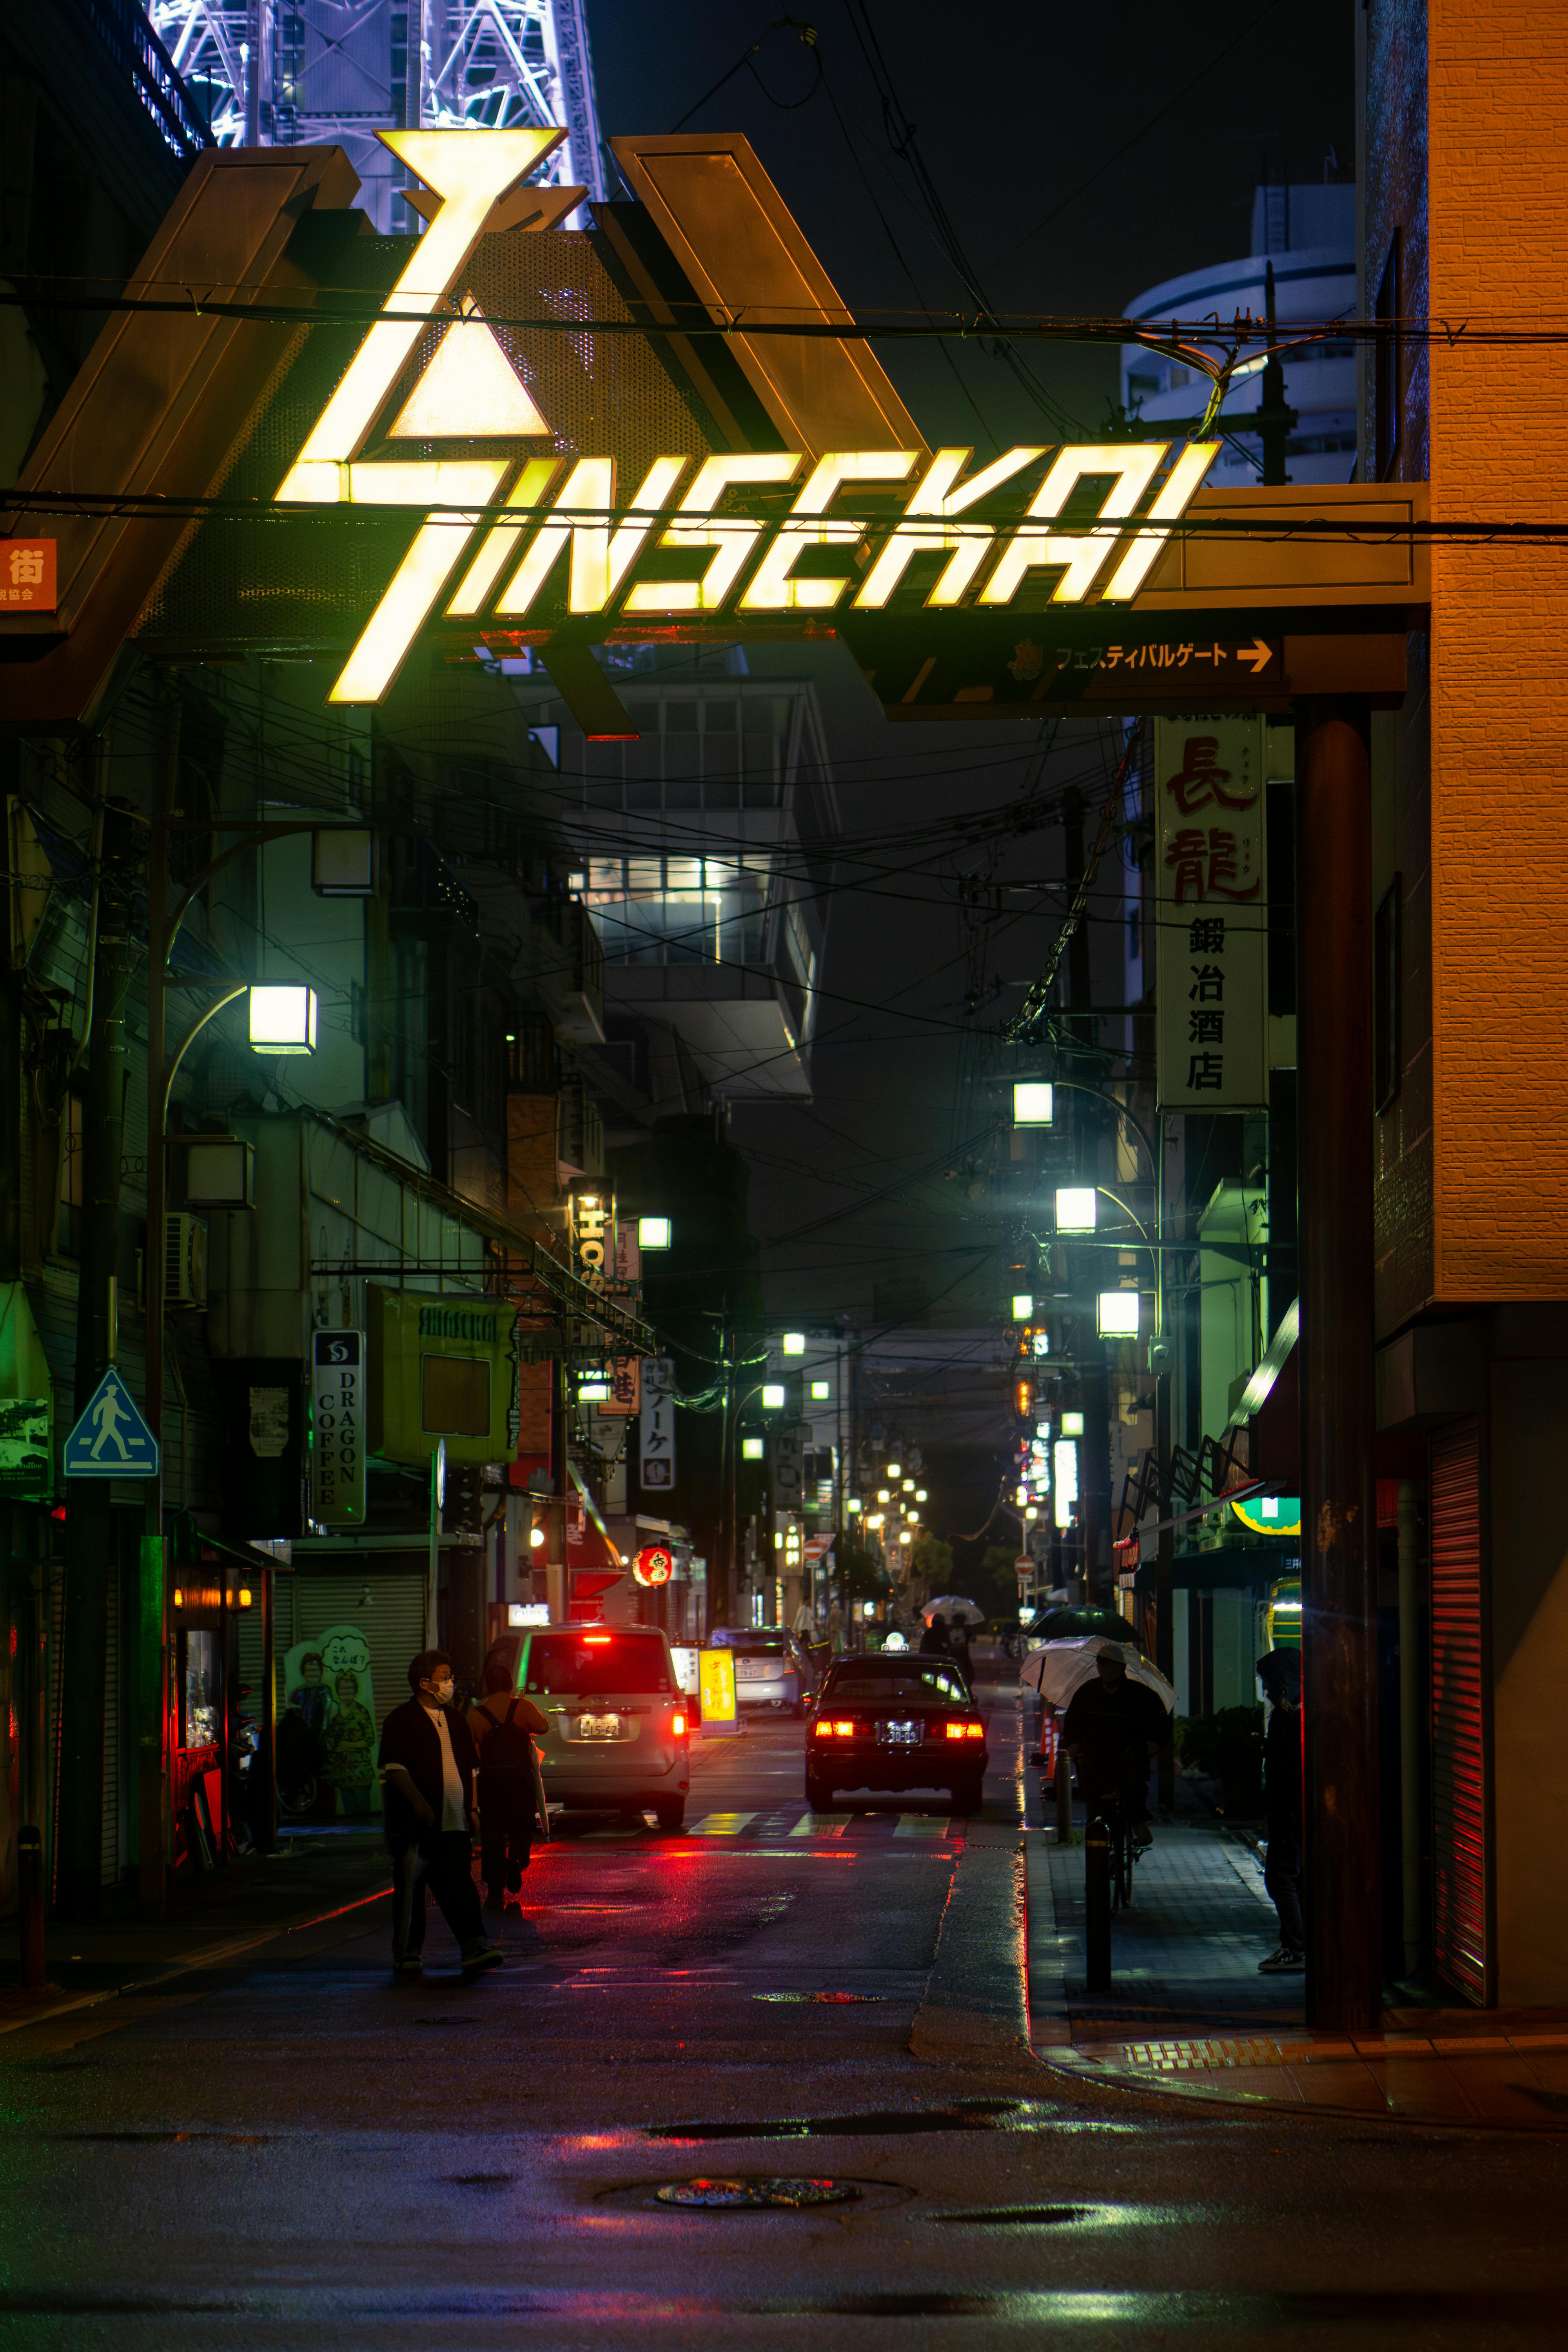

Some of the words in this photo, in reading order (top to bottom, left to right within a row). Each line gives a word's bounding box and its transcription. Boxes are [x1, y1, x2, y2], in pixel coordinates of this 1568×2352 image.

[10, 550, 44, 584] 街
[1056, 642, 1228, 670] フェスティバルゲート
[1187, 917, 1225, 1090] 鍛冶酒店
[319, 1395, 335, 1505] COFFEE
[339, 1372, 356, 1483] DRAGON
